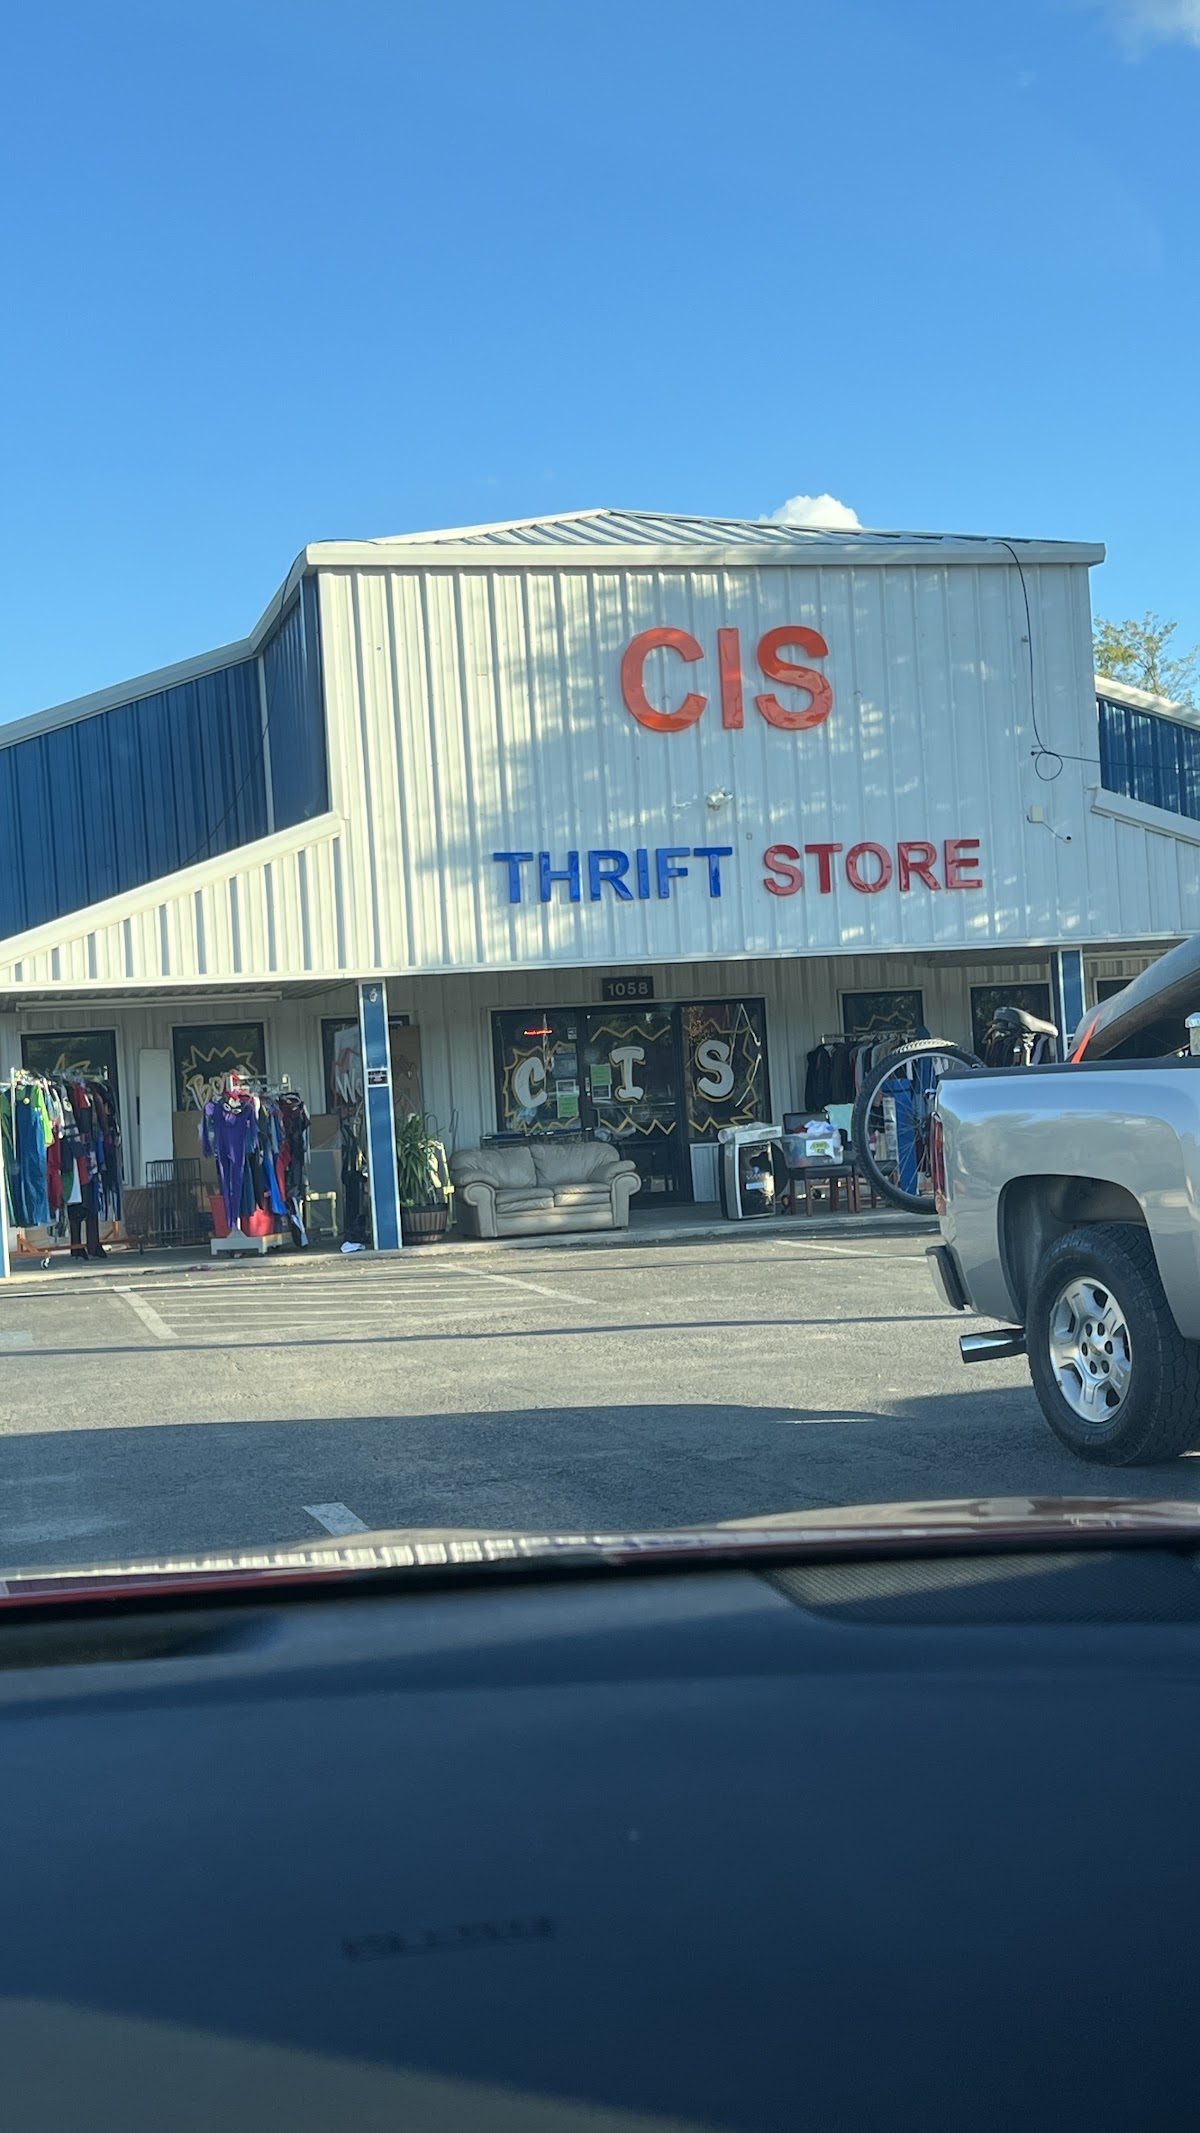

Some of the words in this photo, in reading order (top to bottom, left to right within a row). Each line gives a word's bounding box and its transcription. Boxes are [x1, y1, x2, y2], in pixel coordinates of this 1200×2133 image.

[620, 625, 834, 732] CIS
[493, 846, 733, 904] THRIFT
[763, 838, 984, 896] STORE
[607, 981, 649, 996] 1058
